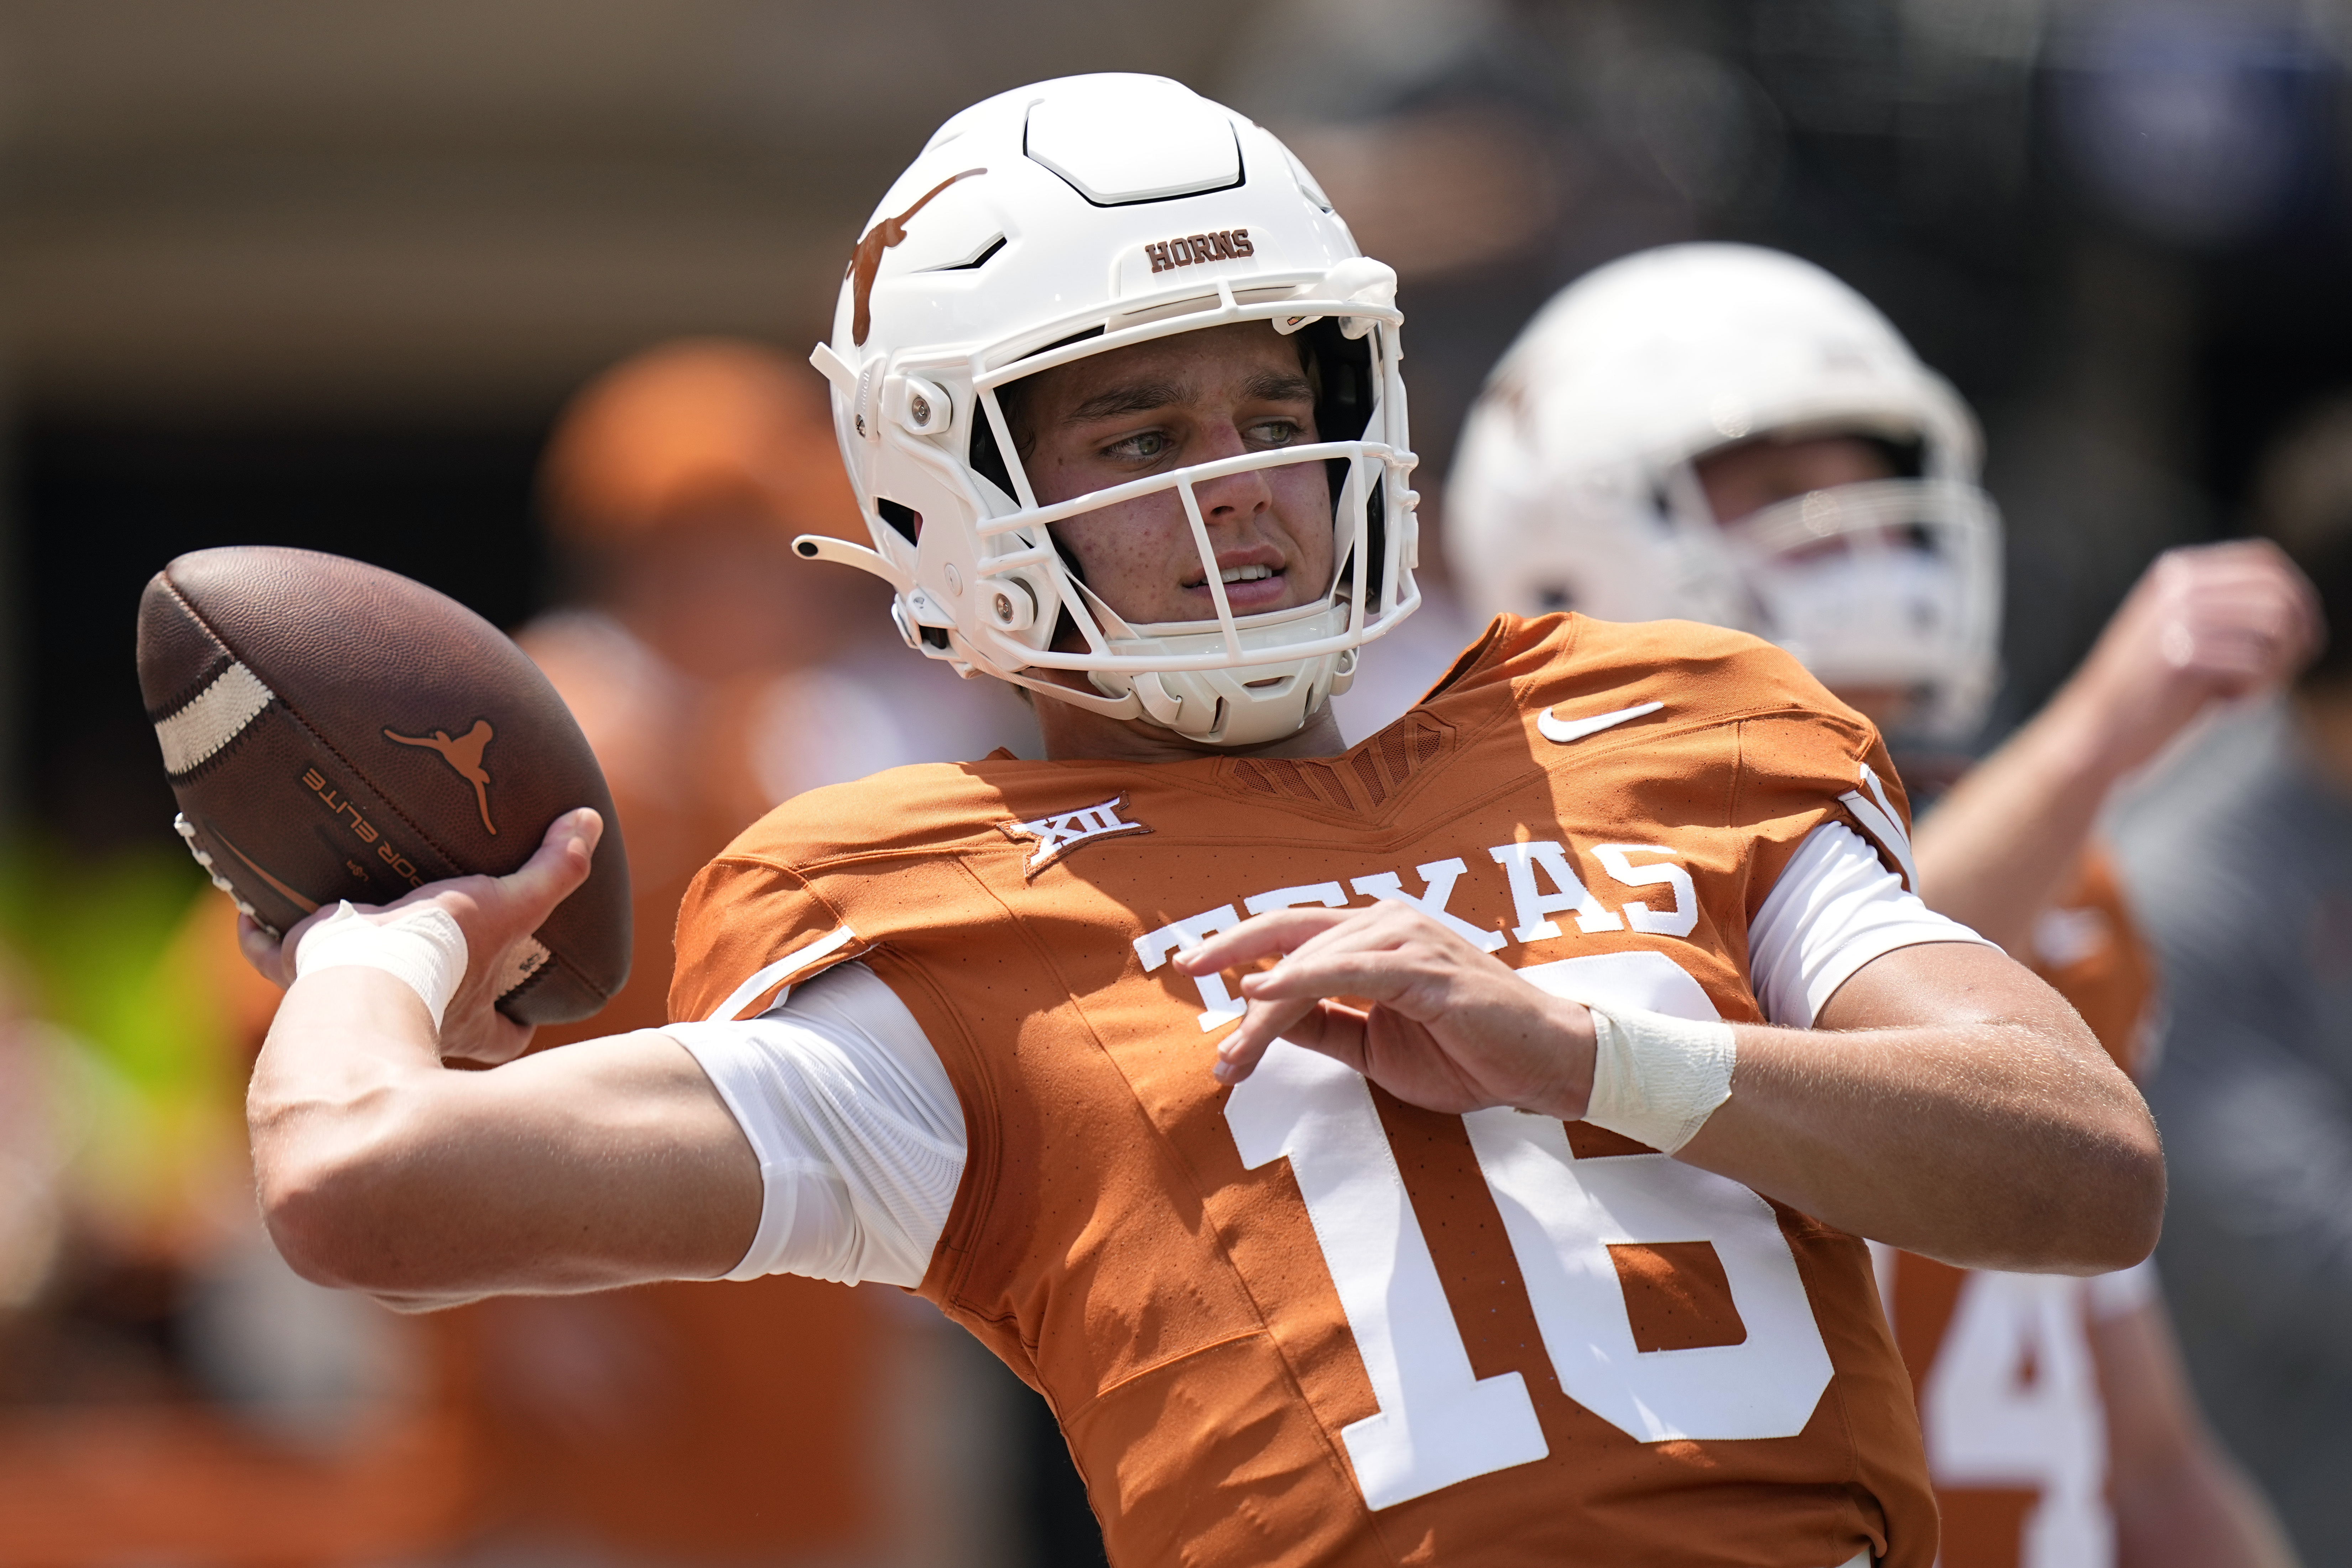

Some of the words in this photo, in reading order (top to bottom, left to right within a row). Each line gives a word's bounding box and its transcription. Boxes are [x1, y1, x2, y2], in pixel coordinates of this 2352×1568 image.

[1145, 229, 1254, 273] HORNS
[302, 767, 379, 843] ELITE
[1009, 797, 1141, 866] XII
[1223, 950, 1835, 1512] 16
